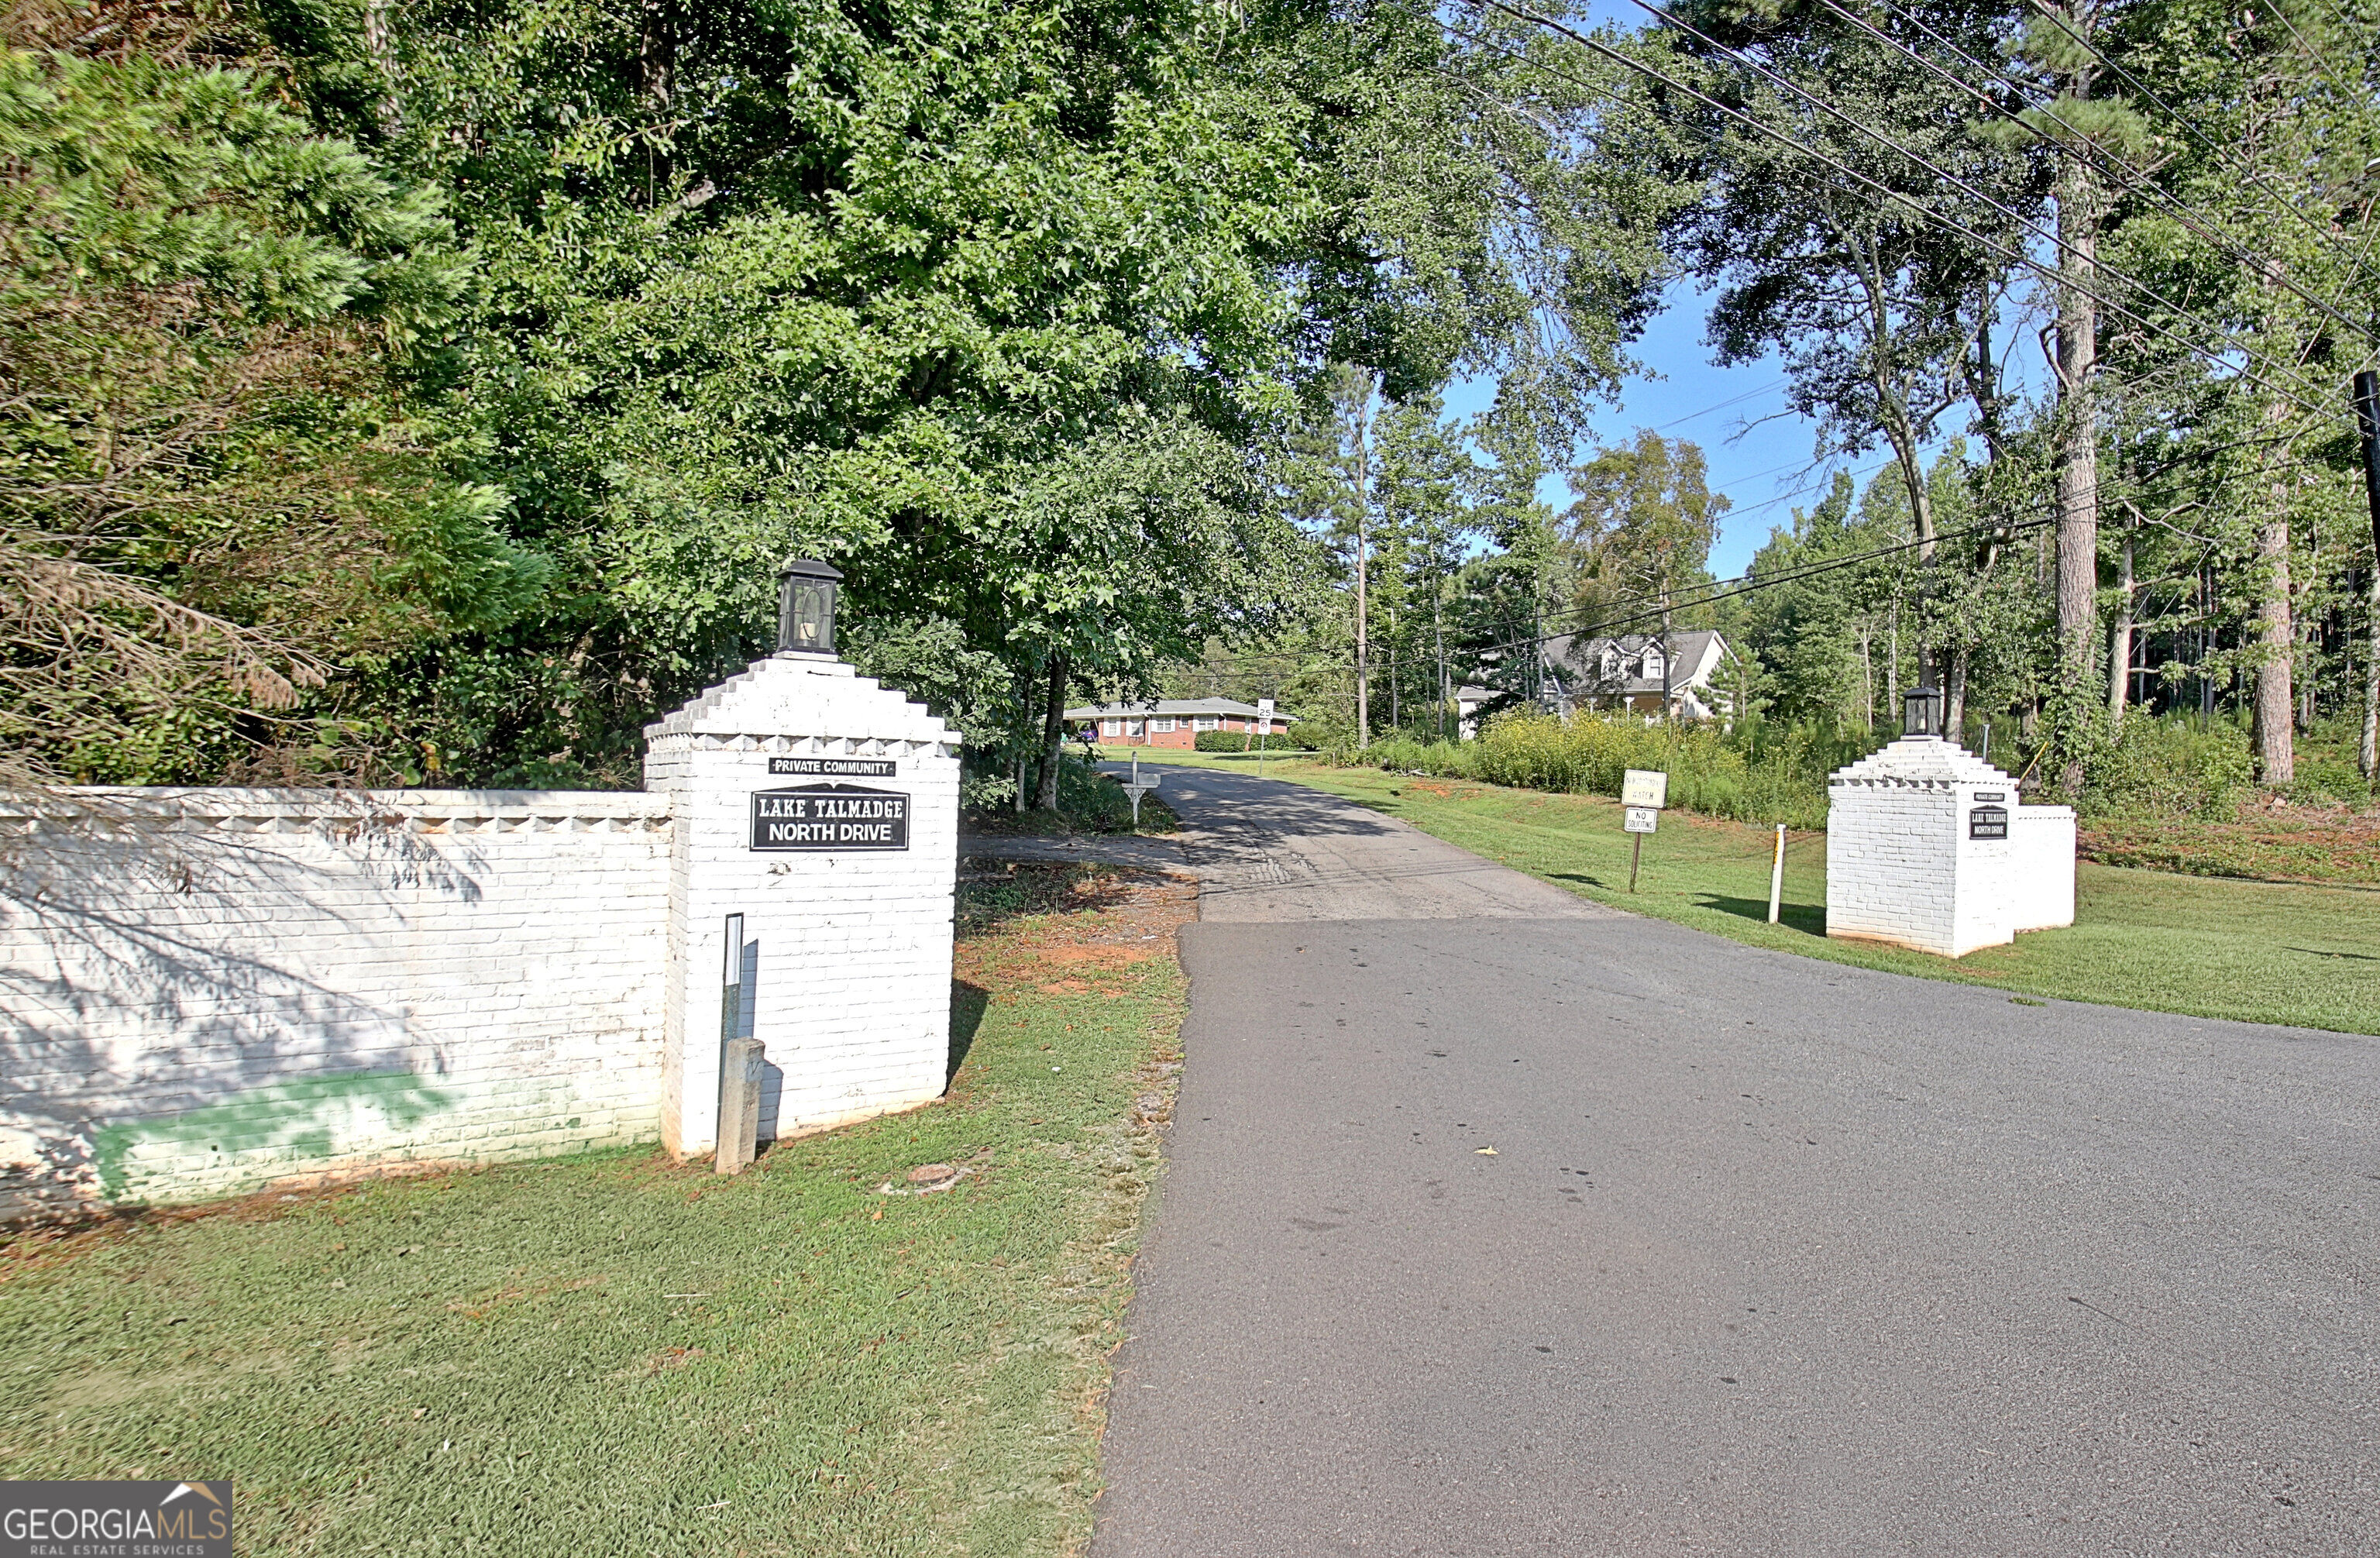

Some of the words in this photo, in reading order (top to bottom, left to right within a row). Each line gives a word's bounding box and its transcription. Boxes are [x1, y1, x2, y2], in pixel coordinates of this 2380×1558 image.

[1259, 708, 1271, 717] 25
[775, 759, 820, 772] PRIVATE
[824, 761, 889, 774] COMMUNITY
[758, 799, 806, 817] LAKE
[815, 800, 903, 818] TALMADGE
[1635, 811, 1646, 820] NO
[1972, 813, 1984, 823] LAKE
[1985, 813, 2007, 823] TALMADGE
[1628, 820, 1653, 829] SOLICITING
[769, 823, 835, 841] NORTH
[840, 824, 892, 841] DRIVE
[1974, 825, 1991, 834] NORTH
[1991, 825, 2004, 834] DRIVE
